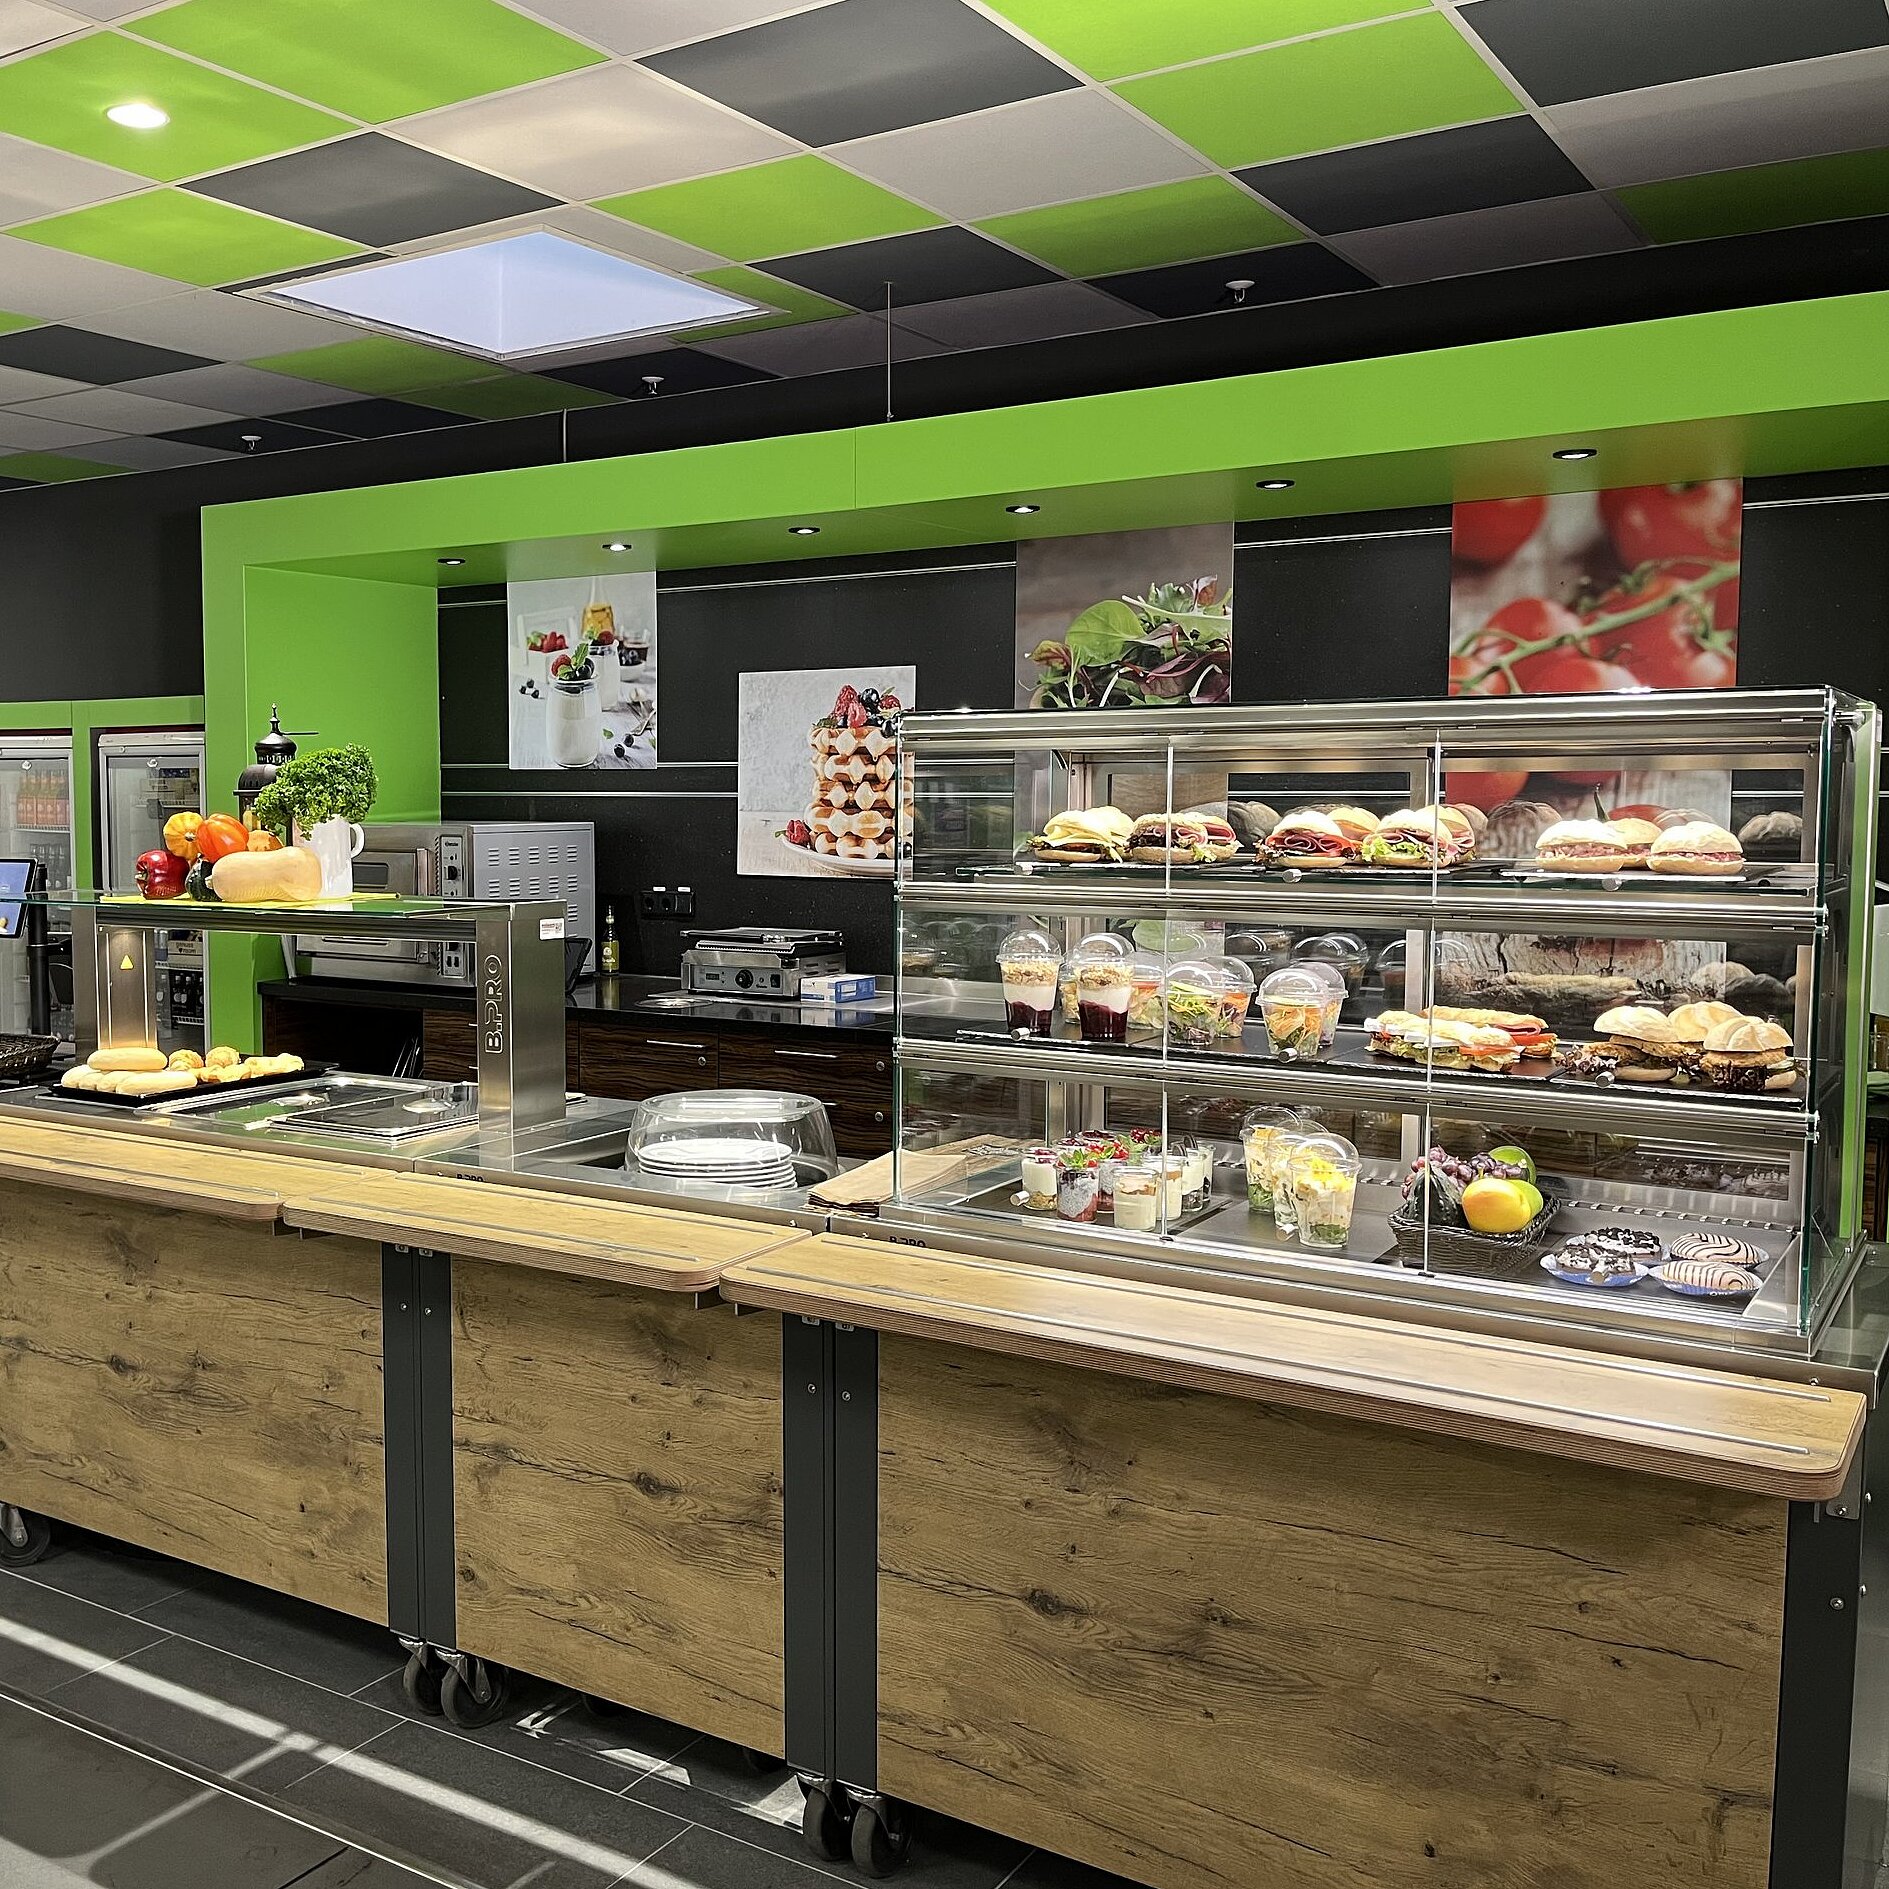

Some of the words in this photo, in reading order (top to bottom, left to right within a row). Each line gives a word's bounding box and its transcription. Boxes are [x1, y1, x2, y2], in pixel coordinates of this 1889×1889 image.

[484, 955, 503, 1053] B.PRO
[456, 1173, 484, 1182] BPRO
[889, 1235, 926, 1248] BPRO
